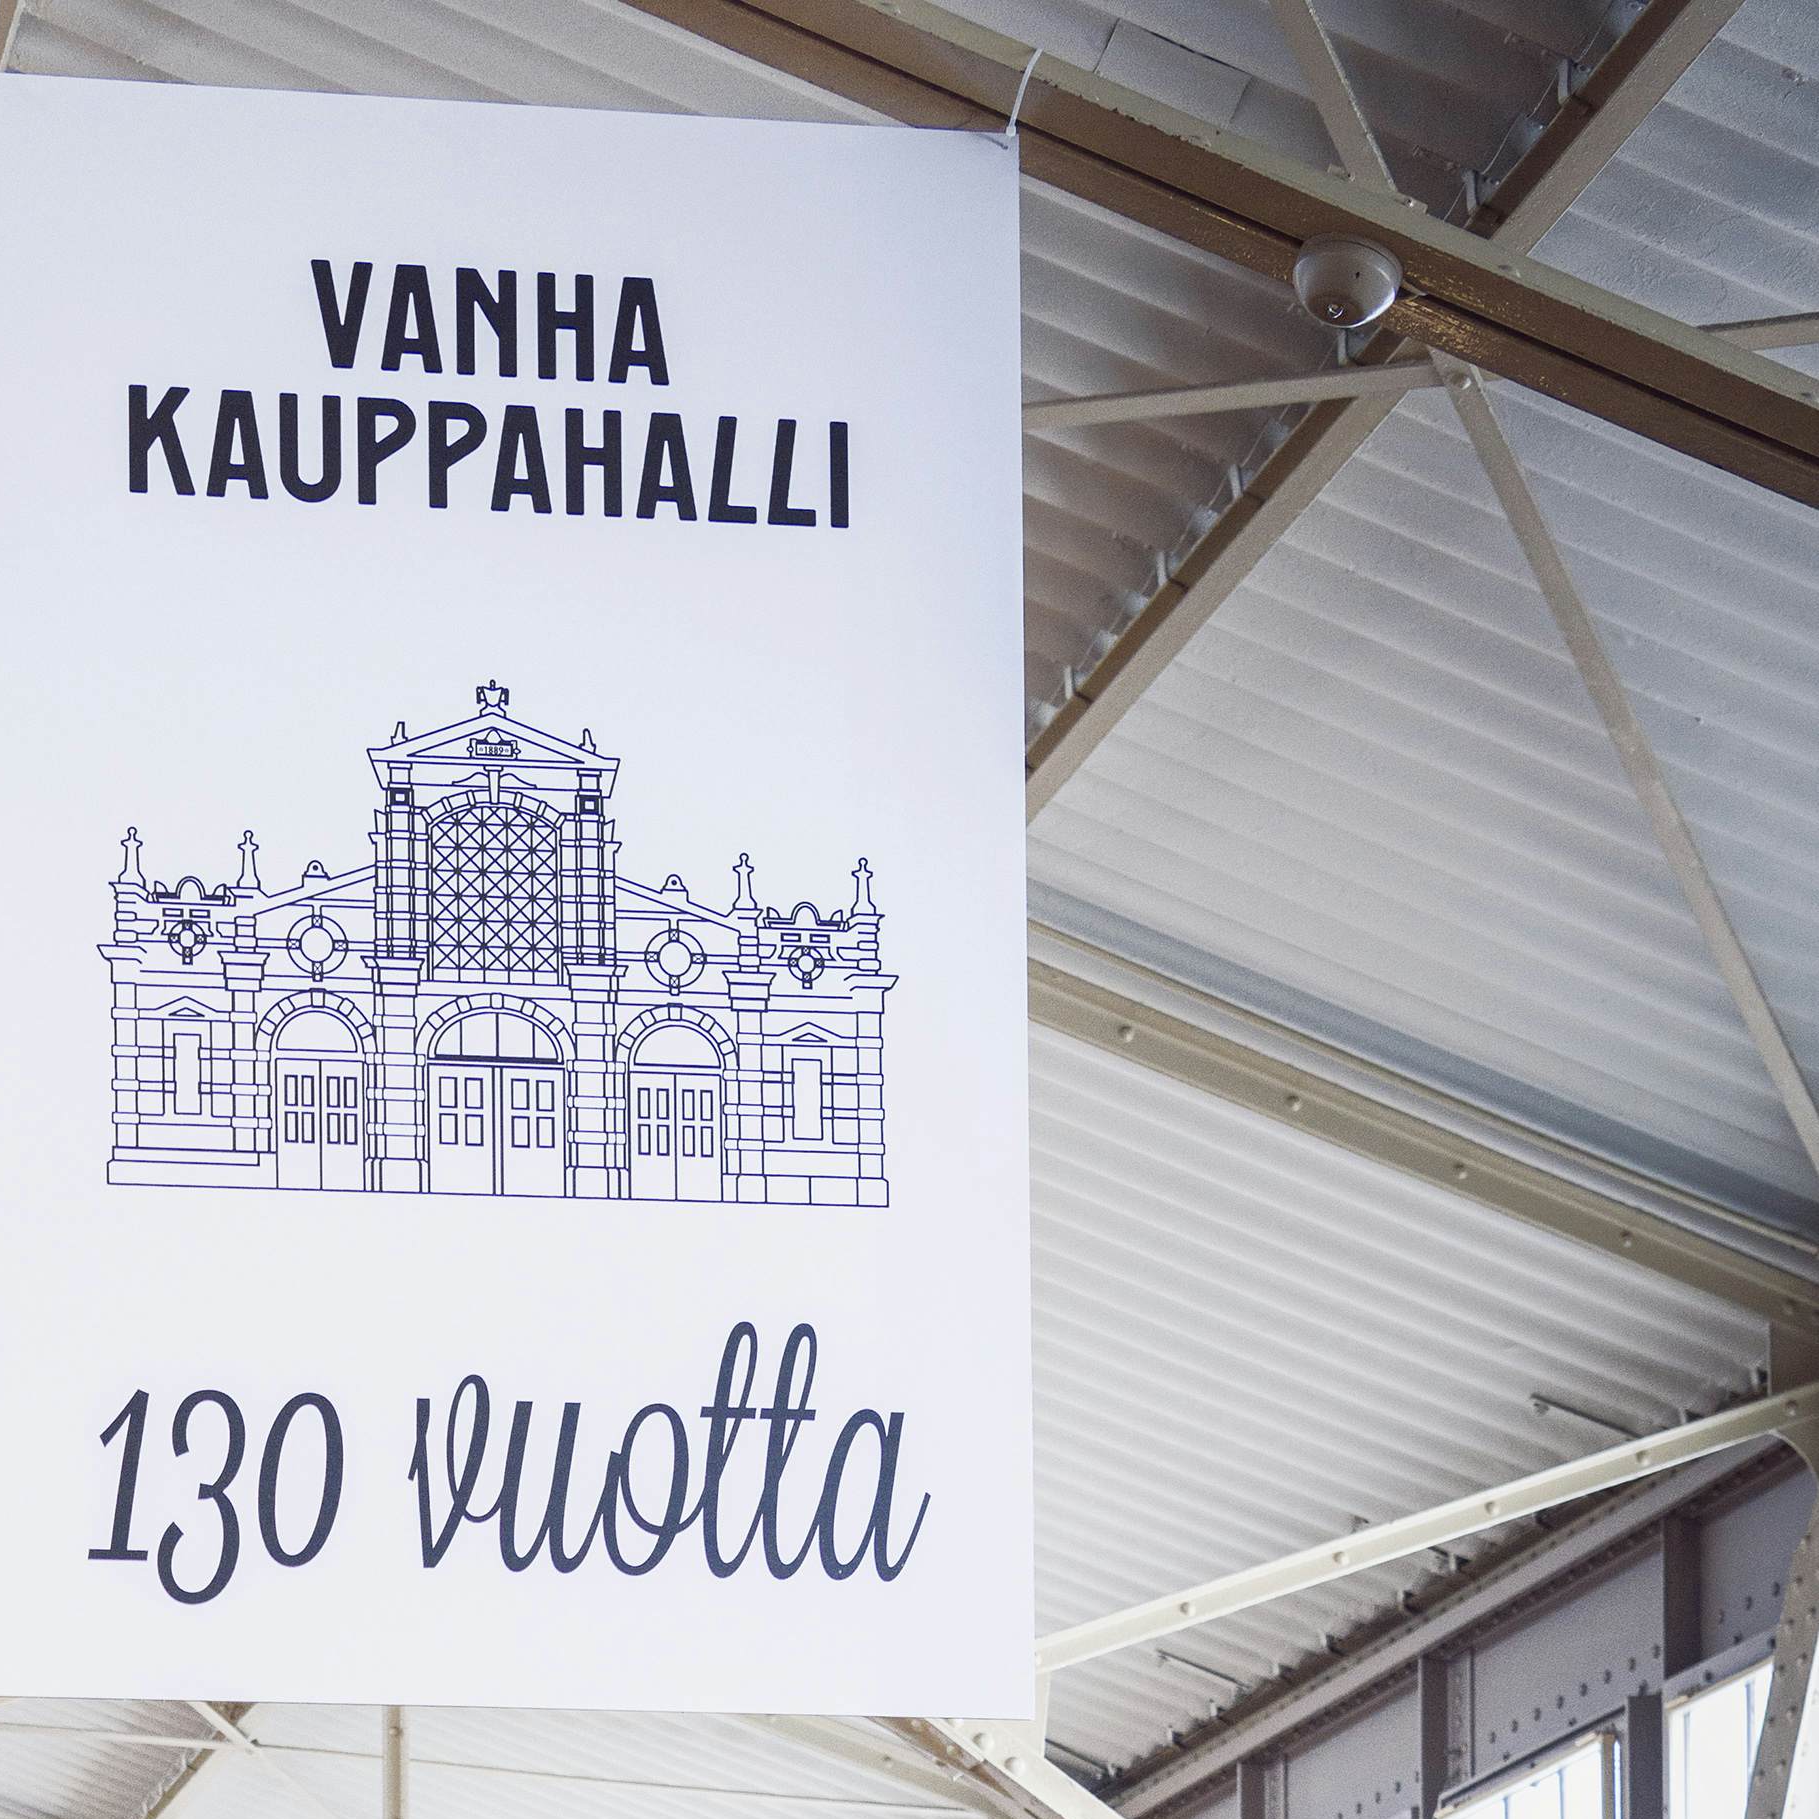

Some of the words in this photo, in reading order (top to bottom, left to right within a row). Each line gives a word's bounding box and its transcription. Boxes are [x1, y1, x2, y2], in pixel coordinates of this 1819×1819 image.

[311, 259, 670, 386] VANHA
[128, 385, 849, 528] KAUPPAHALLI
[88, 1389, 344, 1604] 130
[408, 1321, 931, 1581] vuotta
